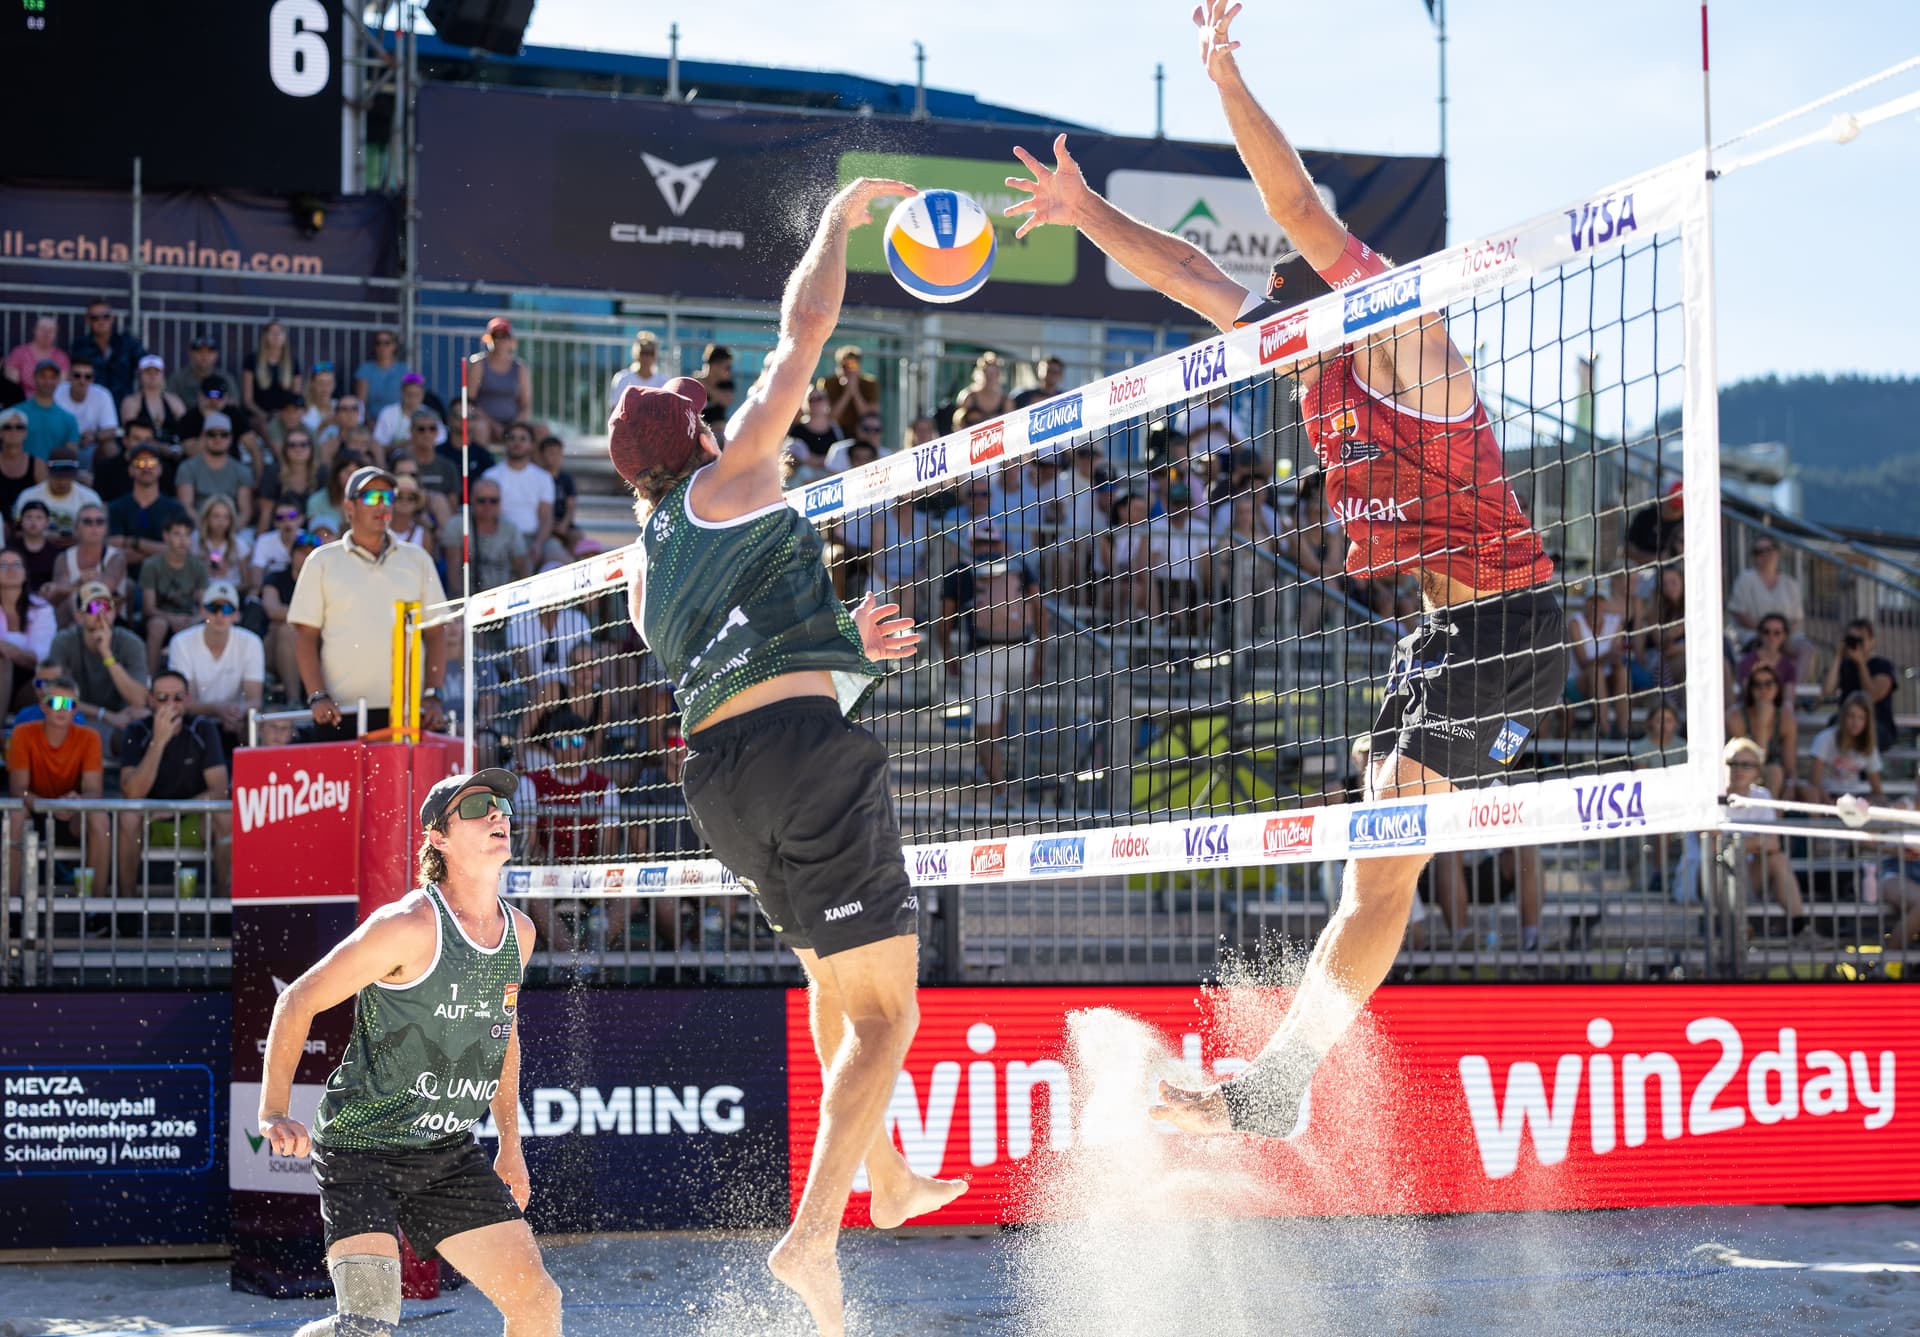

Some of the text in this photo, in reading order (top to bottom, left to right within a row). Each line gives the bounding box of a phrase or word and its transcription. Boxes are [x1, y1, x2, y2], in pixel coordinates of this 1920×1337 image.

[269, 0, 330, 97] 6
[1564, 190, 1638, 251] VISA
[610, 223, 745, 249] CUPRA
[1183, 230, 1292, 256] PLANA
[1178, 341, 1227, 391] VISA
[913, 443, 948, 482] VISA
[656, 525, 675, 542] CEV
[1499, 727, 1524, 747] HYPO
[237, 769, 350, 833] win2day
[1469, 797, 1524, 828] hobex
[1573, 780, 1647, 830] VISA
[1265, 821, 1312, 850] win2day
[1375, 813, 1422, 841] UNIQA
[1049, 844, 1081, 866] UNIQA
[1111, 832, 1150, 858] hobex
[1183, 823, 1230, 862] VISA
[915, 849, 948, 880] VISA
[972, 848, 1006, 875] win2day
[824, 900, 863, 921] XANDI
[450, 983, 458, 1001] 1
[434, 1003, 468, 1019] AUT
[5, 1077, 84, 1095] MEVZA
[447, 1079, 499, 1100] UNIQ
[1459, 1016, 1896, 1179] win2day
[4, 1097, 155, 1120] Beach Volleyball
[4, 1120, 197, 1143] Championships 2026
[4, 1142, 107, 1165] Schladming
[120, 1143, 180, 1160] Austria
